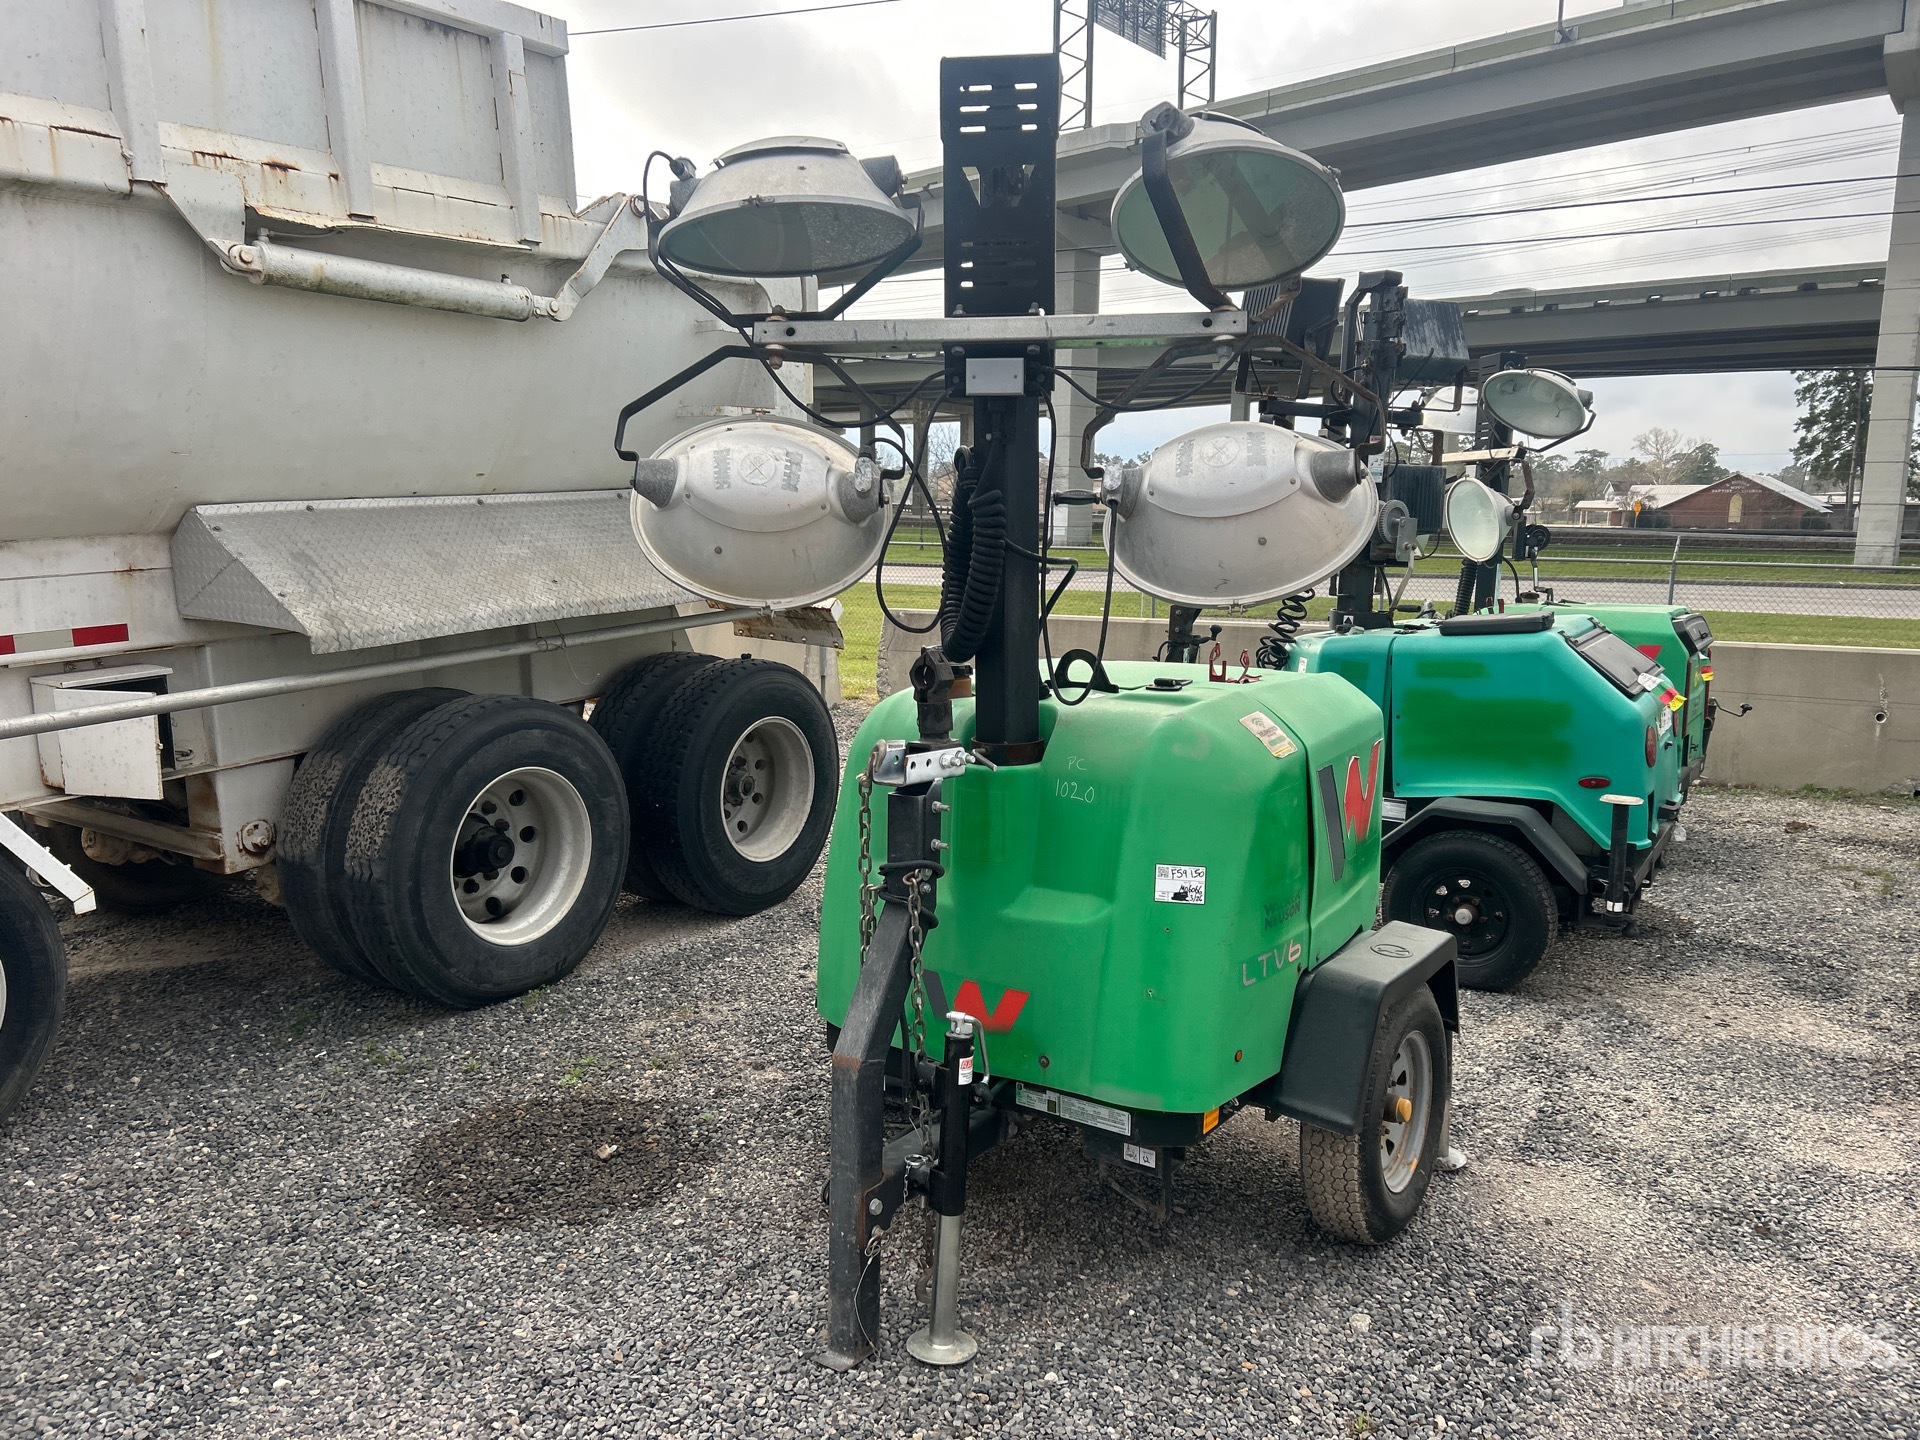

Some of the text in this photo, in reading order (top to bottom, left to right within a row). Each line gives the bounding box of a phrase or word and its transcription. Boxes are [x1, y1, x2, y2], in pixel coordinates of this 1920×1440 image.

[1067, 756, 1087, 771] PC
[1055, 778, 1095, 803] 1020
[1242, 939, 1302, 987] LTV6
